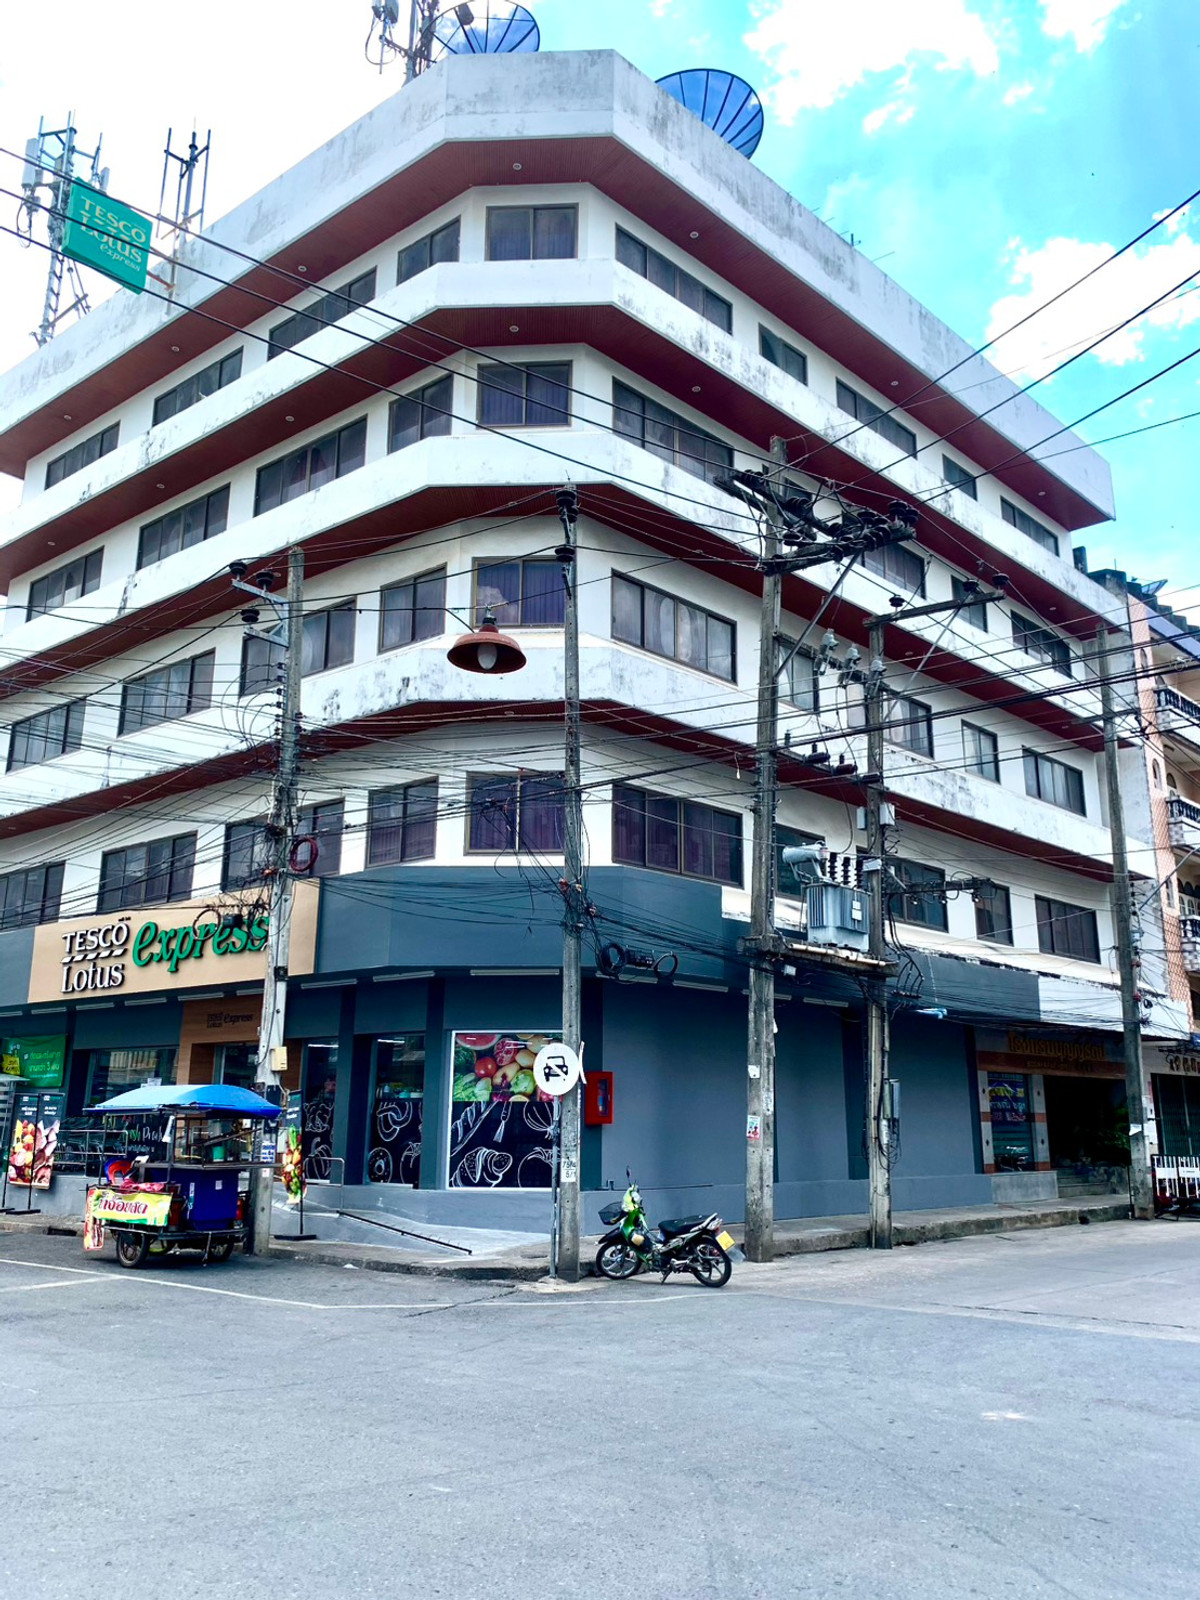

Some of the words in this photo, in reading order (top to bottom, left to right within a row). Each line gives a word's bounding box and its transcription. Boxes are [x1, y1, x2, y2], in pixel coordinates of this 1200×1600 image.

[81, 195, 146, 243] TESCO
[99, 244, 141, 272] express
[62, 923, 129, 954] TESCO
[132, 916, 270, 973] express
[61, 962, 124, 994] Lotus
